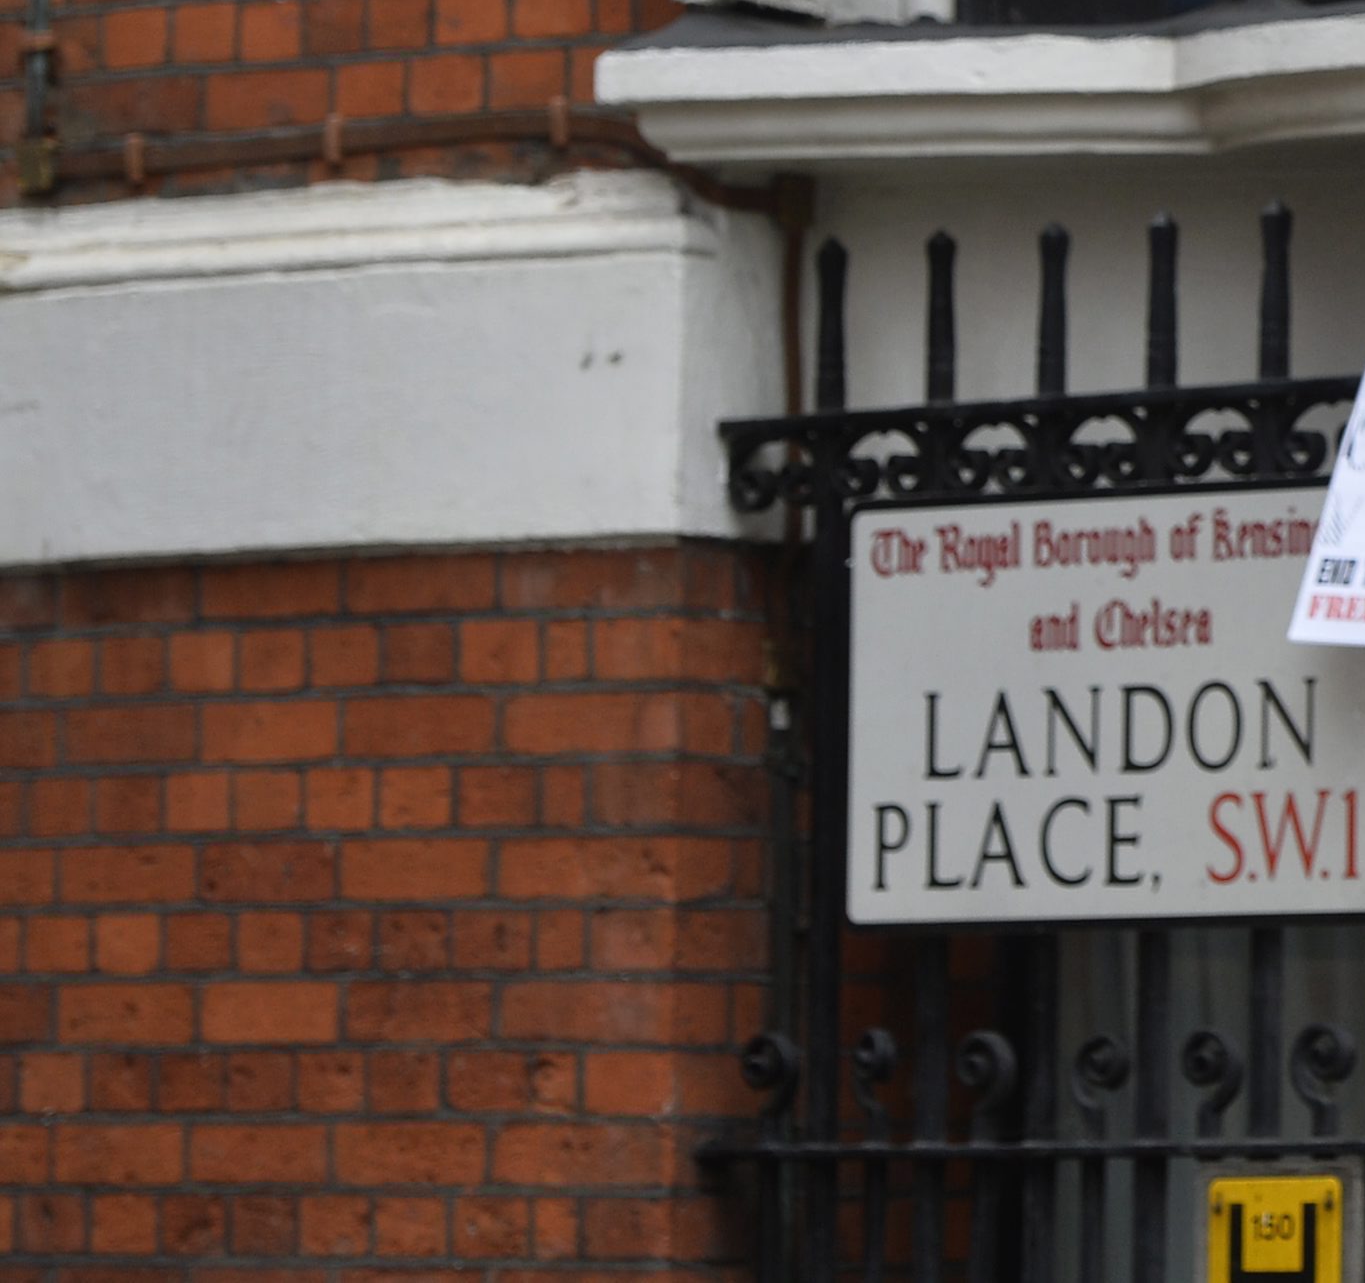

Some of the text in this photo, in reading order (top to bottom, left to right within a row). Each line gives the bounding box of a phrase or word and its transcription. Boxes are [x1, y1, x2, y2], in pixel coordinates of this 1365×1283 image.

[871, 506, 1318, 588] The Royal Borough of Kensin
[1317, 557, 1357, 586] END
[1029, 597, 1213, 652] and Chelsea
[924, 676, 1318, 780] LANDON
[872, 788, 1360, 892] PLACE, S.W.1
